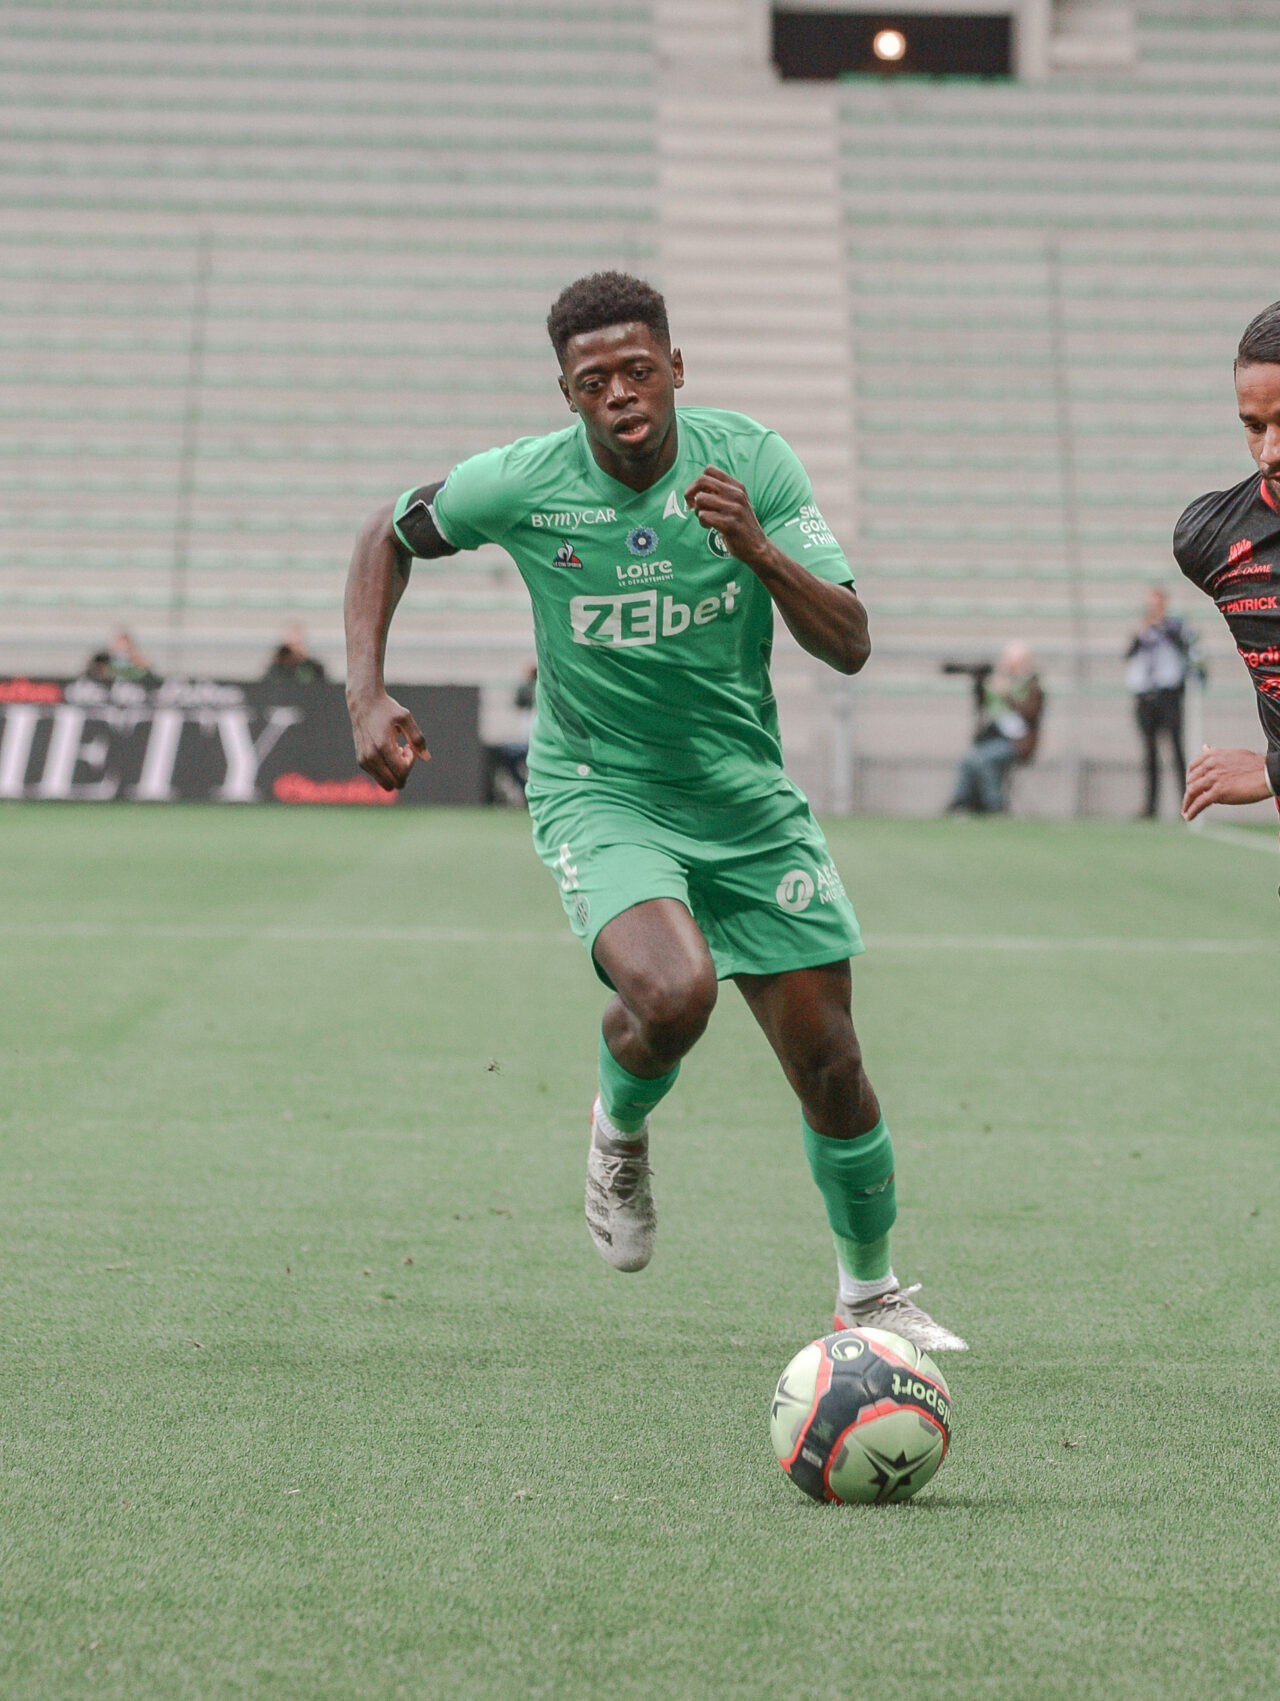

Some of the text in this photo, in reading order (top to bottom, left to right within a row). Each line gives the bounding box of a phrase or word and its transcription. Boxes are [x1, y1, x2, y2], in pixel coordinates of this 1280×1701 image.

[531, 508, 618, 531] BYmyCAR
[570, 580, 742, 648] ZEbet
[1226, 595, 1278, 613] PATRICK
